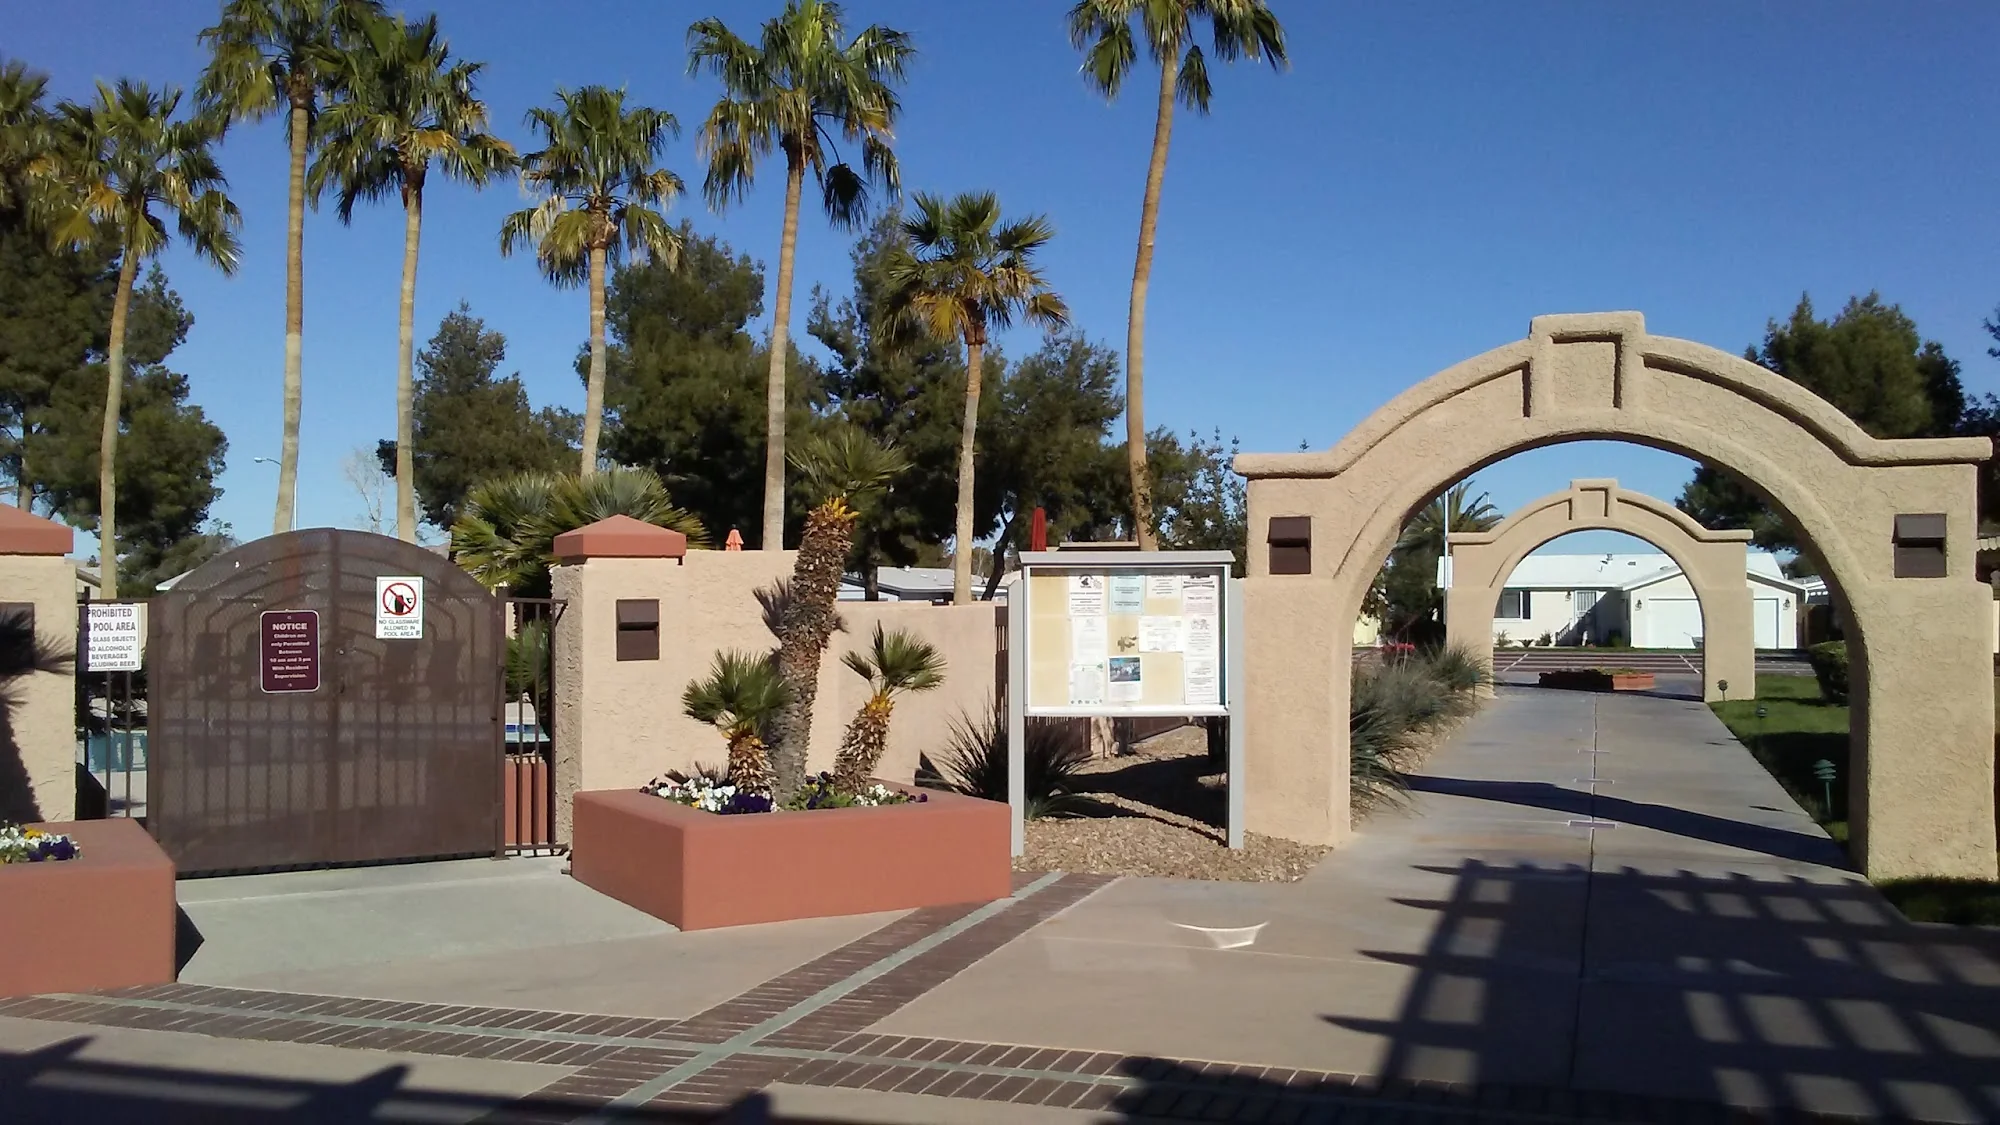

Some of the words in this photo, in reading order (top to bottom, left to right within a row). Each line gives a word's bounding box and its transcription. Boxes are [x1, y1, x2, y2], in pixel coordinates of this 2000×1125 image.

[93, 622, 114, 631] POOL
[115, 622, 137, 631] AREA
[272, 622, 308, 631] NOTICE
